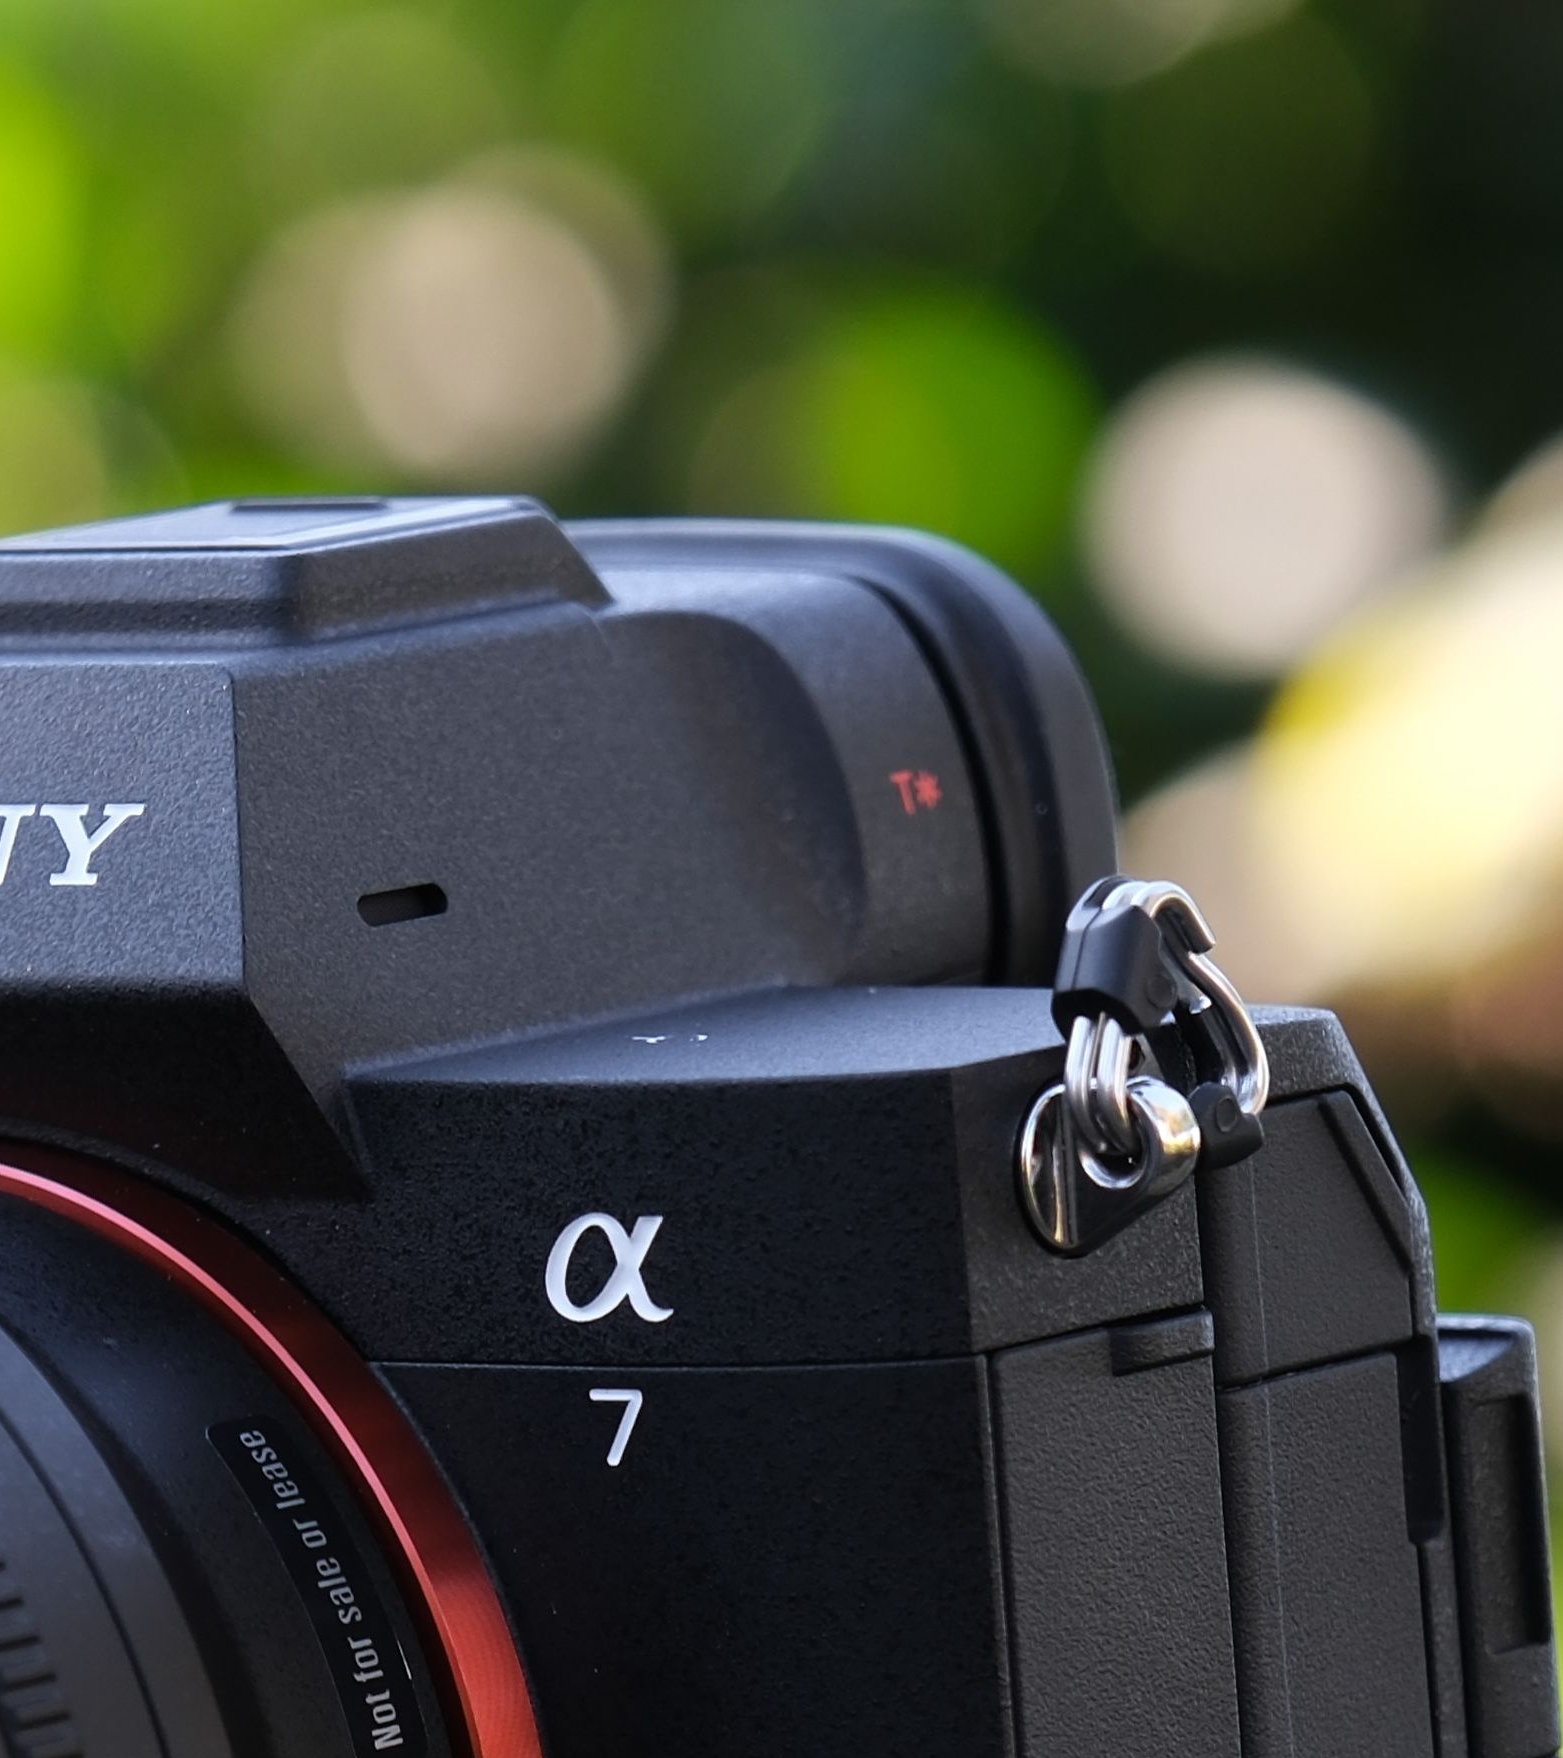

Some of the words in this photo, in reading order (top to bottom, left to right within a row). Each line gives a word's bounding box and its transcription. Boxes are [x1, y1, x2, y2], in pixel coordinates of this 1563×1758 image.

[545, 1211, 674, 1322] α
[589, 1388, 643, 1467] 7
[239, 1429, 306, 1510] lease
[292, 1517, 328, 1549] or
[315, 1556, 363, 1625] sale
[346, 1636, 384, 1683] for
[365, 1687, 404, 1751] Not
